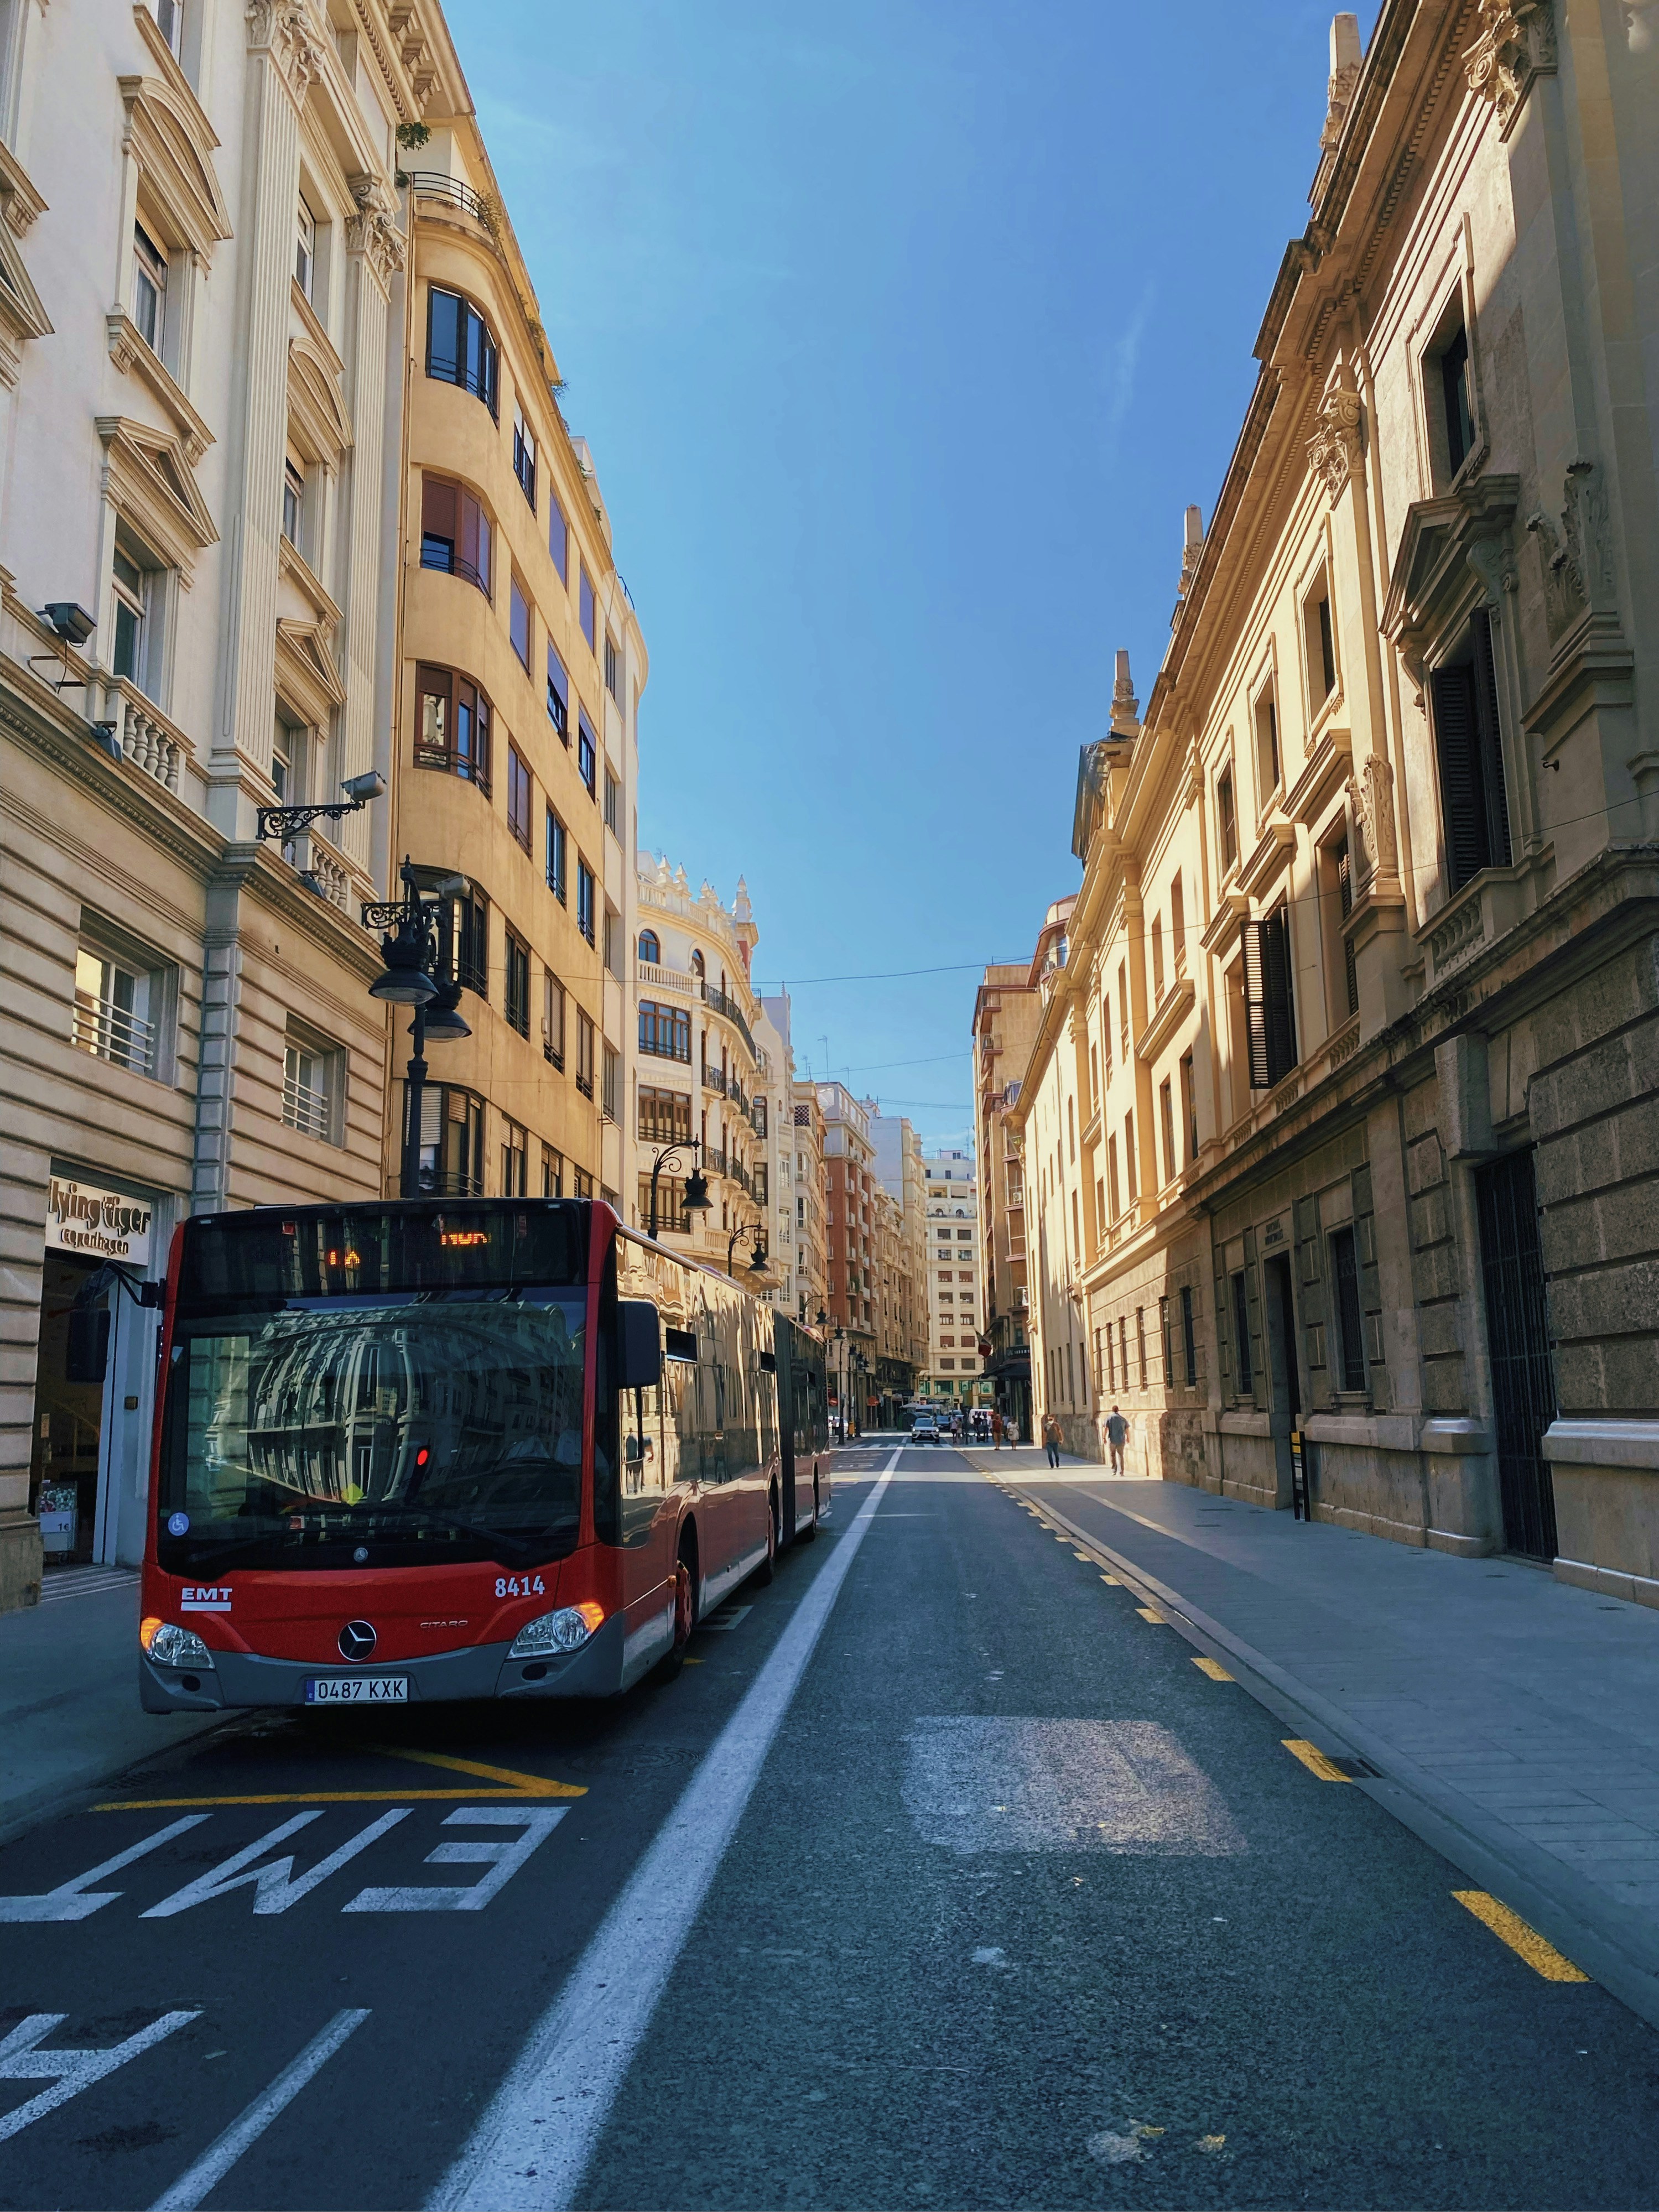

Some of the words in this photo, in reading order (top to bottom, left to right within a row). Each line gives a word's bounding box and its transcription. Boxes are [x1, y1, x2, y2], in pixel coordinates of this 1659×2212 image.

[49, 1178, 101, 1230] lying
[102, 1196, 151, 1237] tiger
[61, 1228, 129, 1256] copenhagen
[58, 1522, 70, 1532] 1€
[181, 1588, 233, 1600] EMT
[495, 1575, 545, 1598] 8414
[419, 1620, 469, 1629] CITARO
[318, 1682, 363, 1699] 0487
[369, 1680, 404, 1699] KXK
[0, 1806, 571, 1922] EMT
